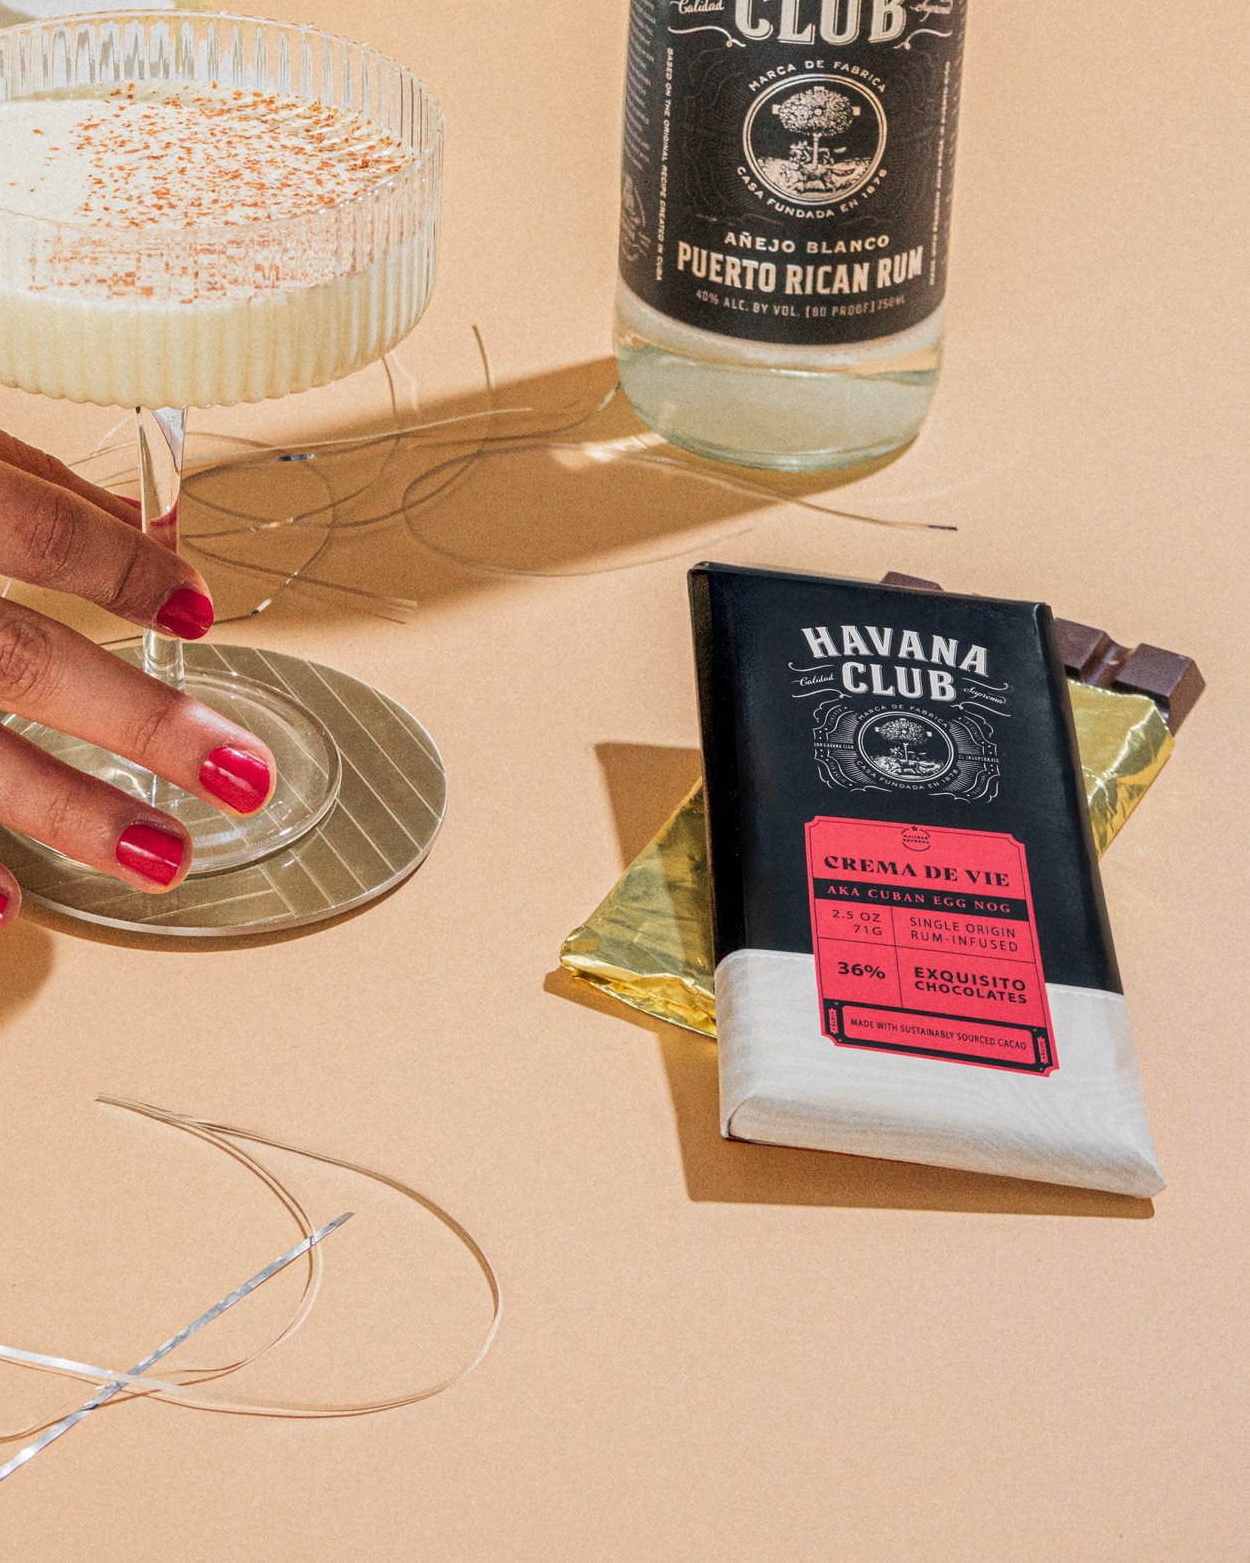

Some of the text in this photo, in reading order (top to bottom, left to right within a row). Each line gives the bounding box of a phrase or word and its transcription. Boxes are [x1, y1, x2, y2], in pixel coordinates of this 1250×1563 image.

[664, 47, 674, 81] BASED
[749, 59, 886, 93] MARCA DE FABRICA
[664, 82, 672, 97] ON
[663, 99, 672, 117] THE
[661, 119, 671, 162] ORIGINAL
[659, 164, 669, 198] RECIPE
[737, 166, 764, 199] CASA
[766, 198, 835, 219] FUNDADA
[840, 199, 859, 213] EN
[656, 199, 667, 242] CREATED
[724, 231, 890, 254] AÑEJO BLANCO
[655, 255, 664, 281] CUBA
[677, 241, 924, 295] PUERTO RICAN RUM
[695, 289, 719, 305] 40%
[723, 297, 749, 312] ALC.
[752, 301, 769, 314] BY
[801, 625, 989, 678] HAVANA
[791, 672, 835, 687] Calidad
[841, 661, 957, 702] CLUB
[963, 687, 1007, 704] Suprema
[857, 705, 888, 721] MARCA
[909, 705, 949, 729] FABRICA
[856, 759, 877, 779] CASA
[879, 776, 925, 790] FUNDADA
[927, 780, 940, 789] EN
[824, 855, 1010, 887] CREMA DE VIE
[827, 885, 1011, 913] AKA CUBAN EGG NOG
[832, 909, 880, 922] 2.5 OZ
[910, 916, 1016, 938] SINGLE ORIGIN
[853, 924, 883, 936] 71G
[911, 930, 1018, 952] RUM-INFUSED
[837, 961, 886, 979] 36%
[914, 966, 1026, 991] EXQUISITO
[914, 980, 1027, 1004] CHOCOLATES
[850, 1018, 1027, 1051] MADE WITH SUSTAINABLY SOURCED CACAO
